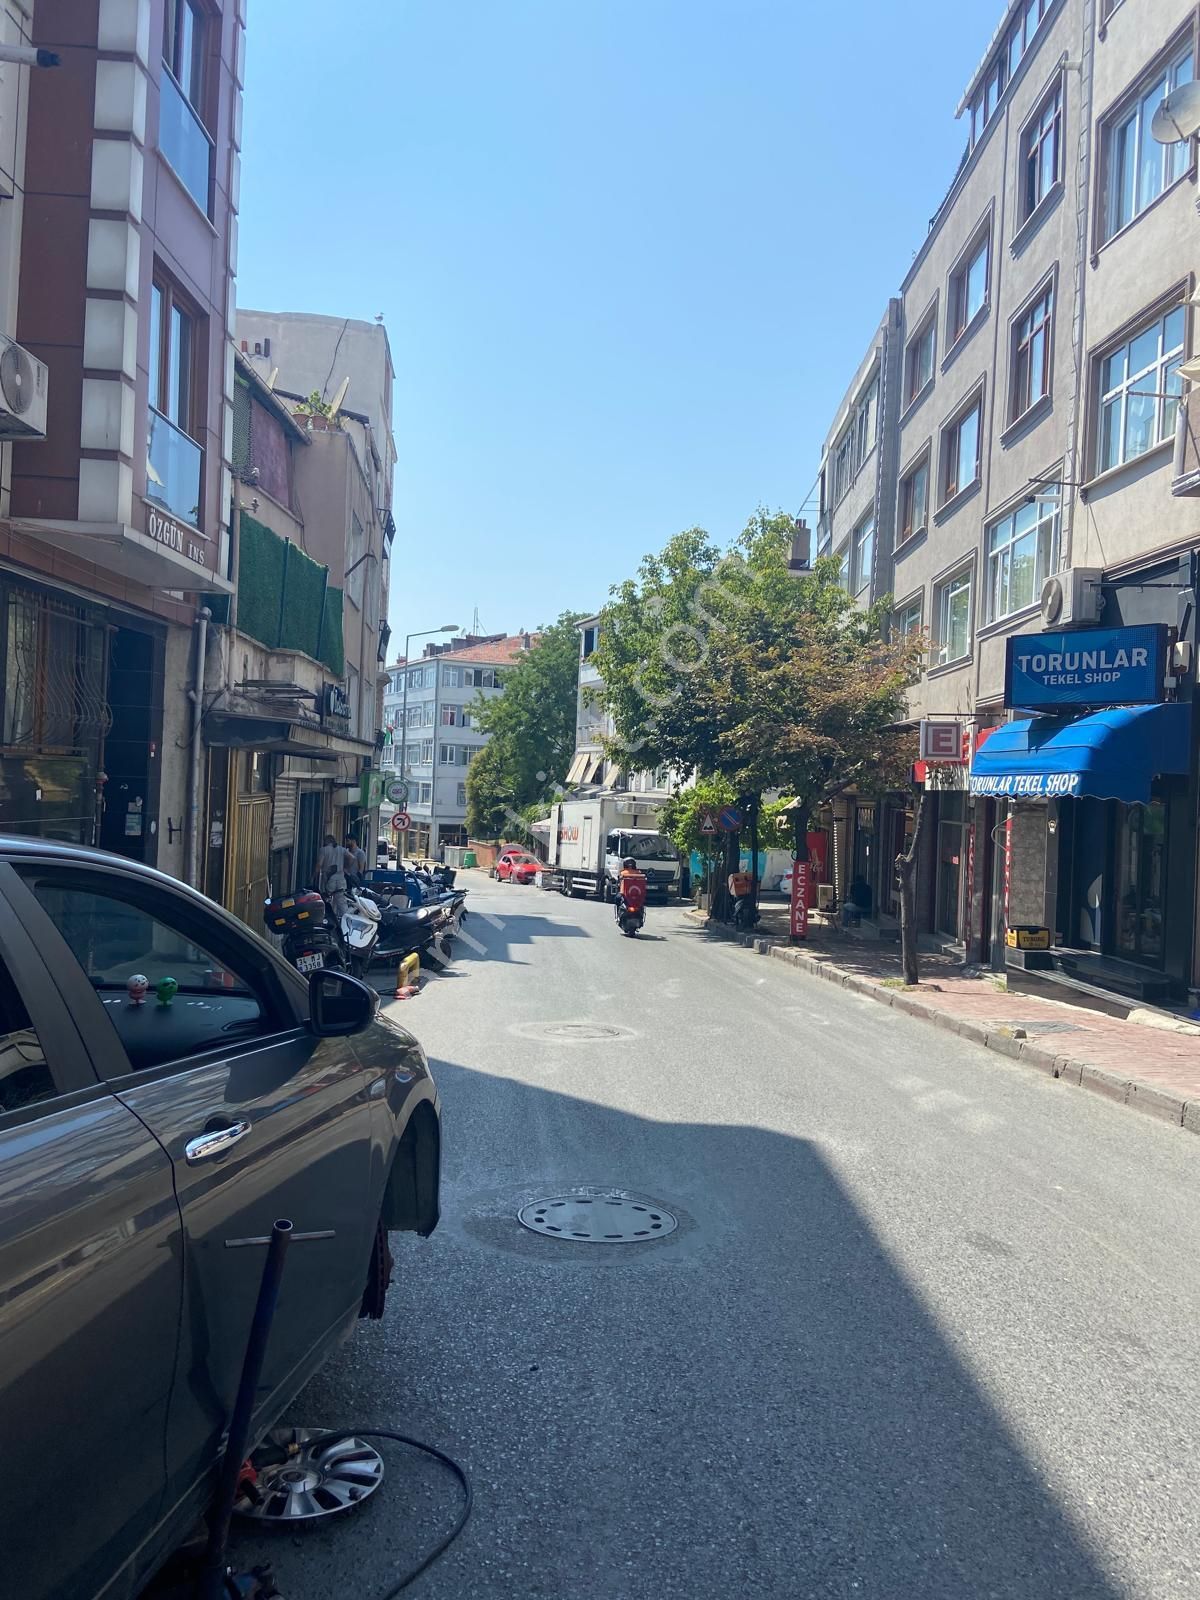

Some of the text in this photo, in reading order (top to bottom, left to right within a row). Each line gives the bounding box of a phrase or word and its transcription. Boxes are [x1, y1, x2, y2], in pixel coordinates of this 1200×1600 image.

[149, 507, 184, 552] ÖZGÜN
[1018, 648, 1147, 673] TORUNLAR
[1043, 672, 1121, 685] TEKEL SHOP
[1013, 775, 1044, 792] TEKEL
[1045, 773, 1079, 792] SHOP
[795, 864, 806, 932] ECZANE
